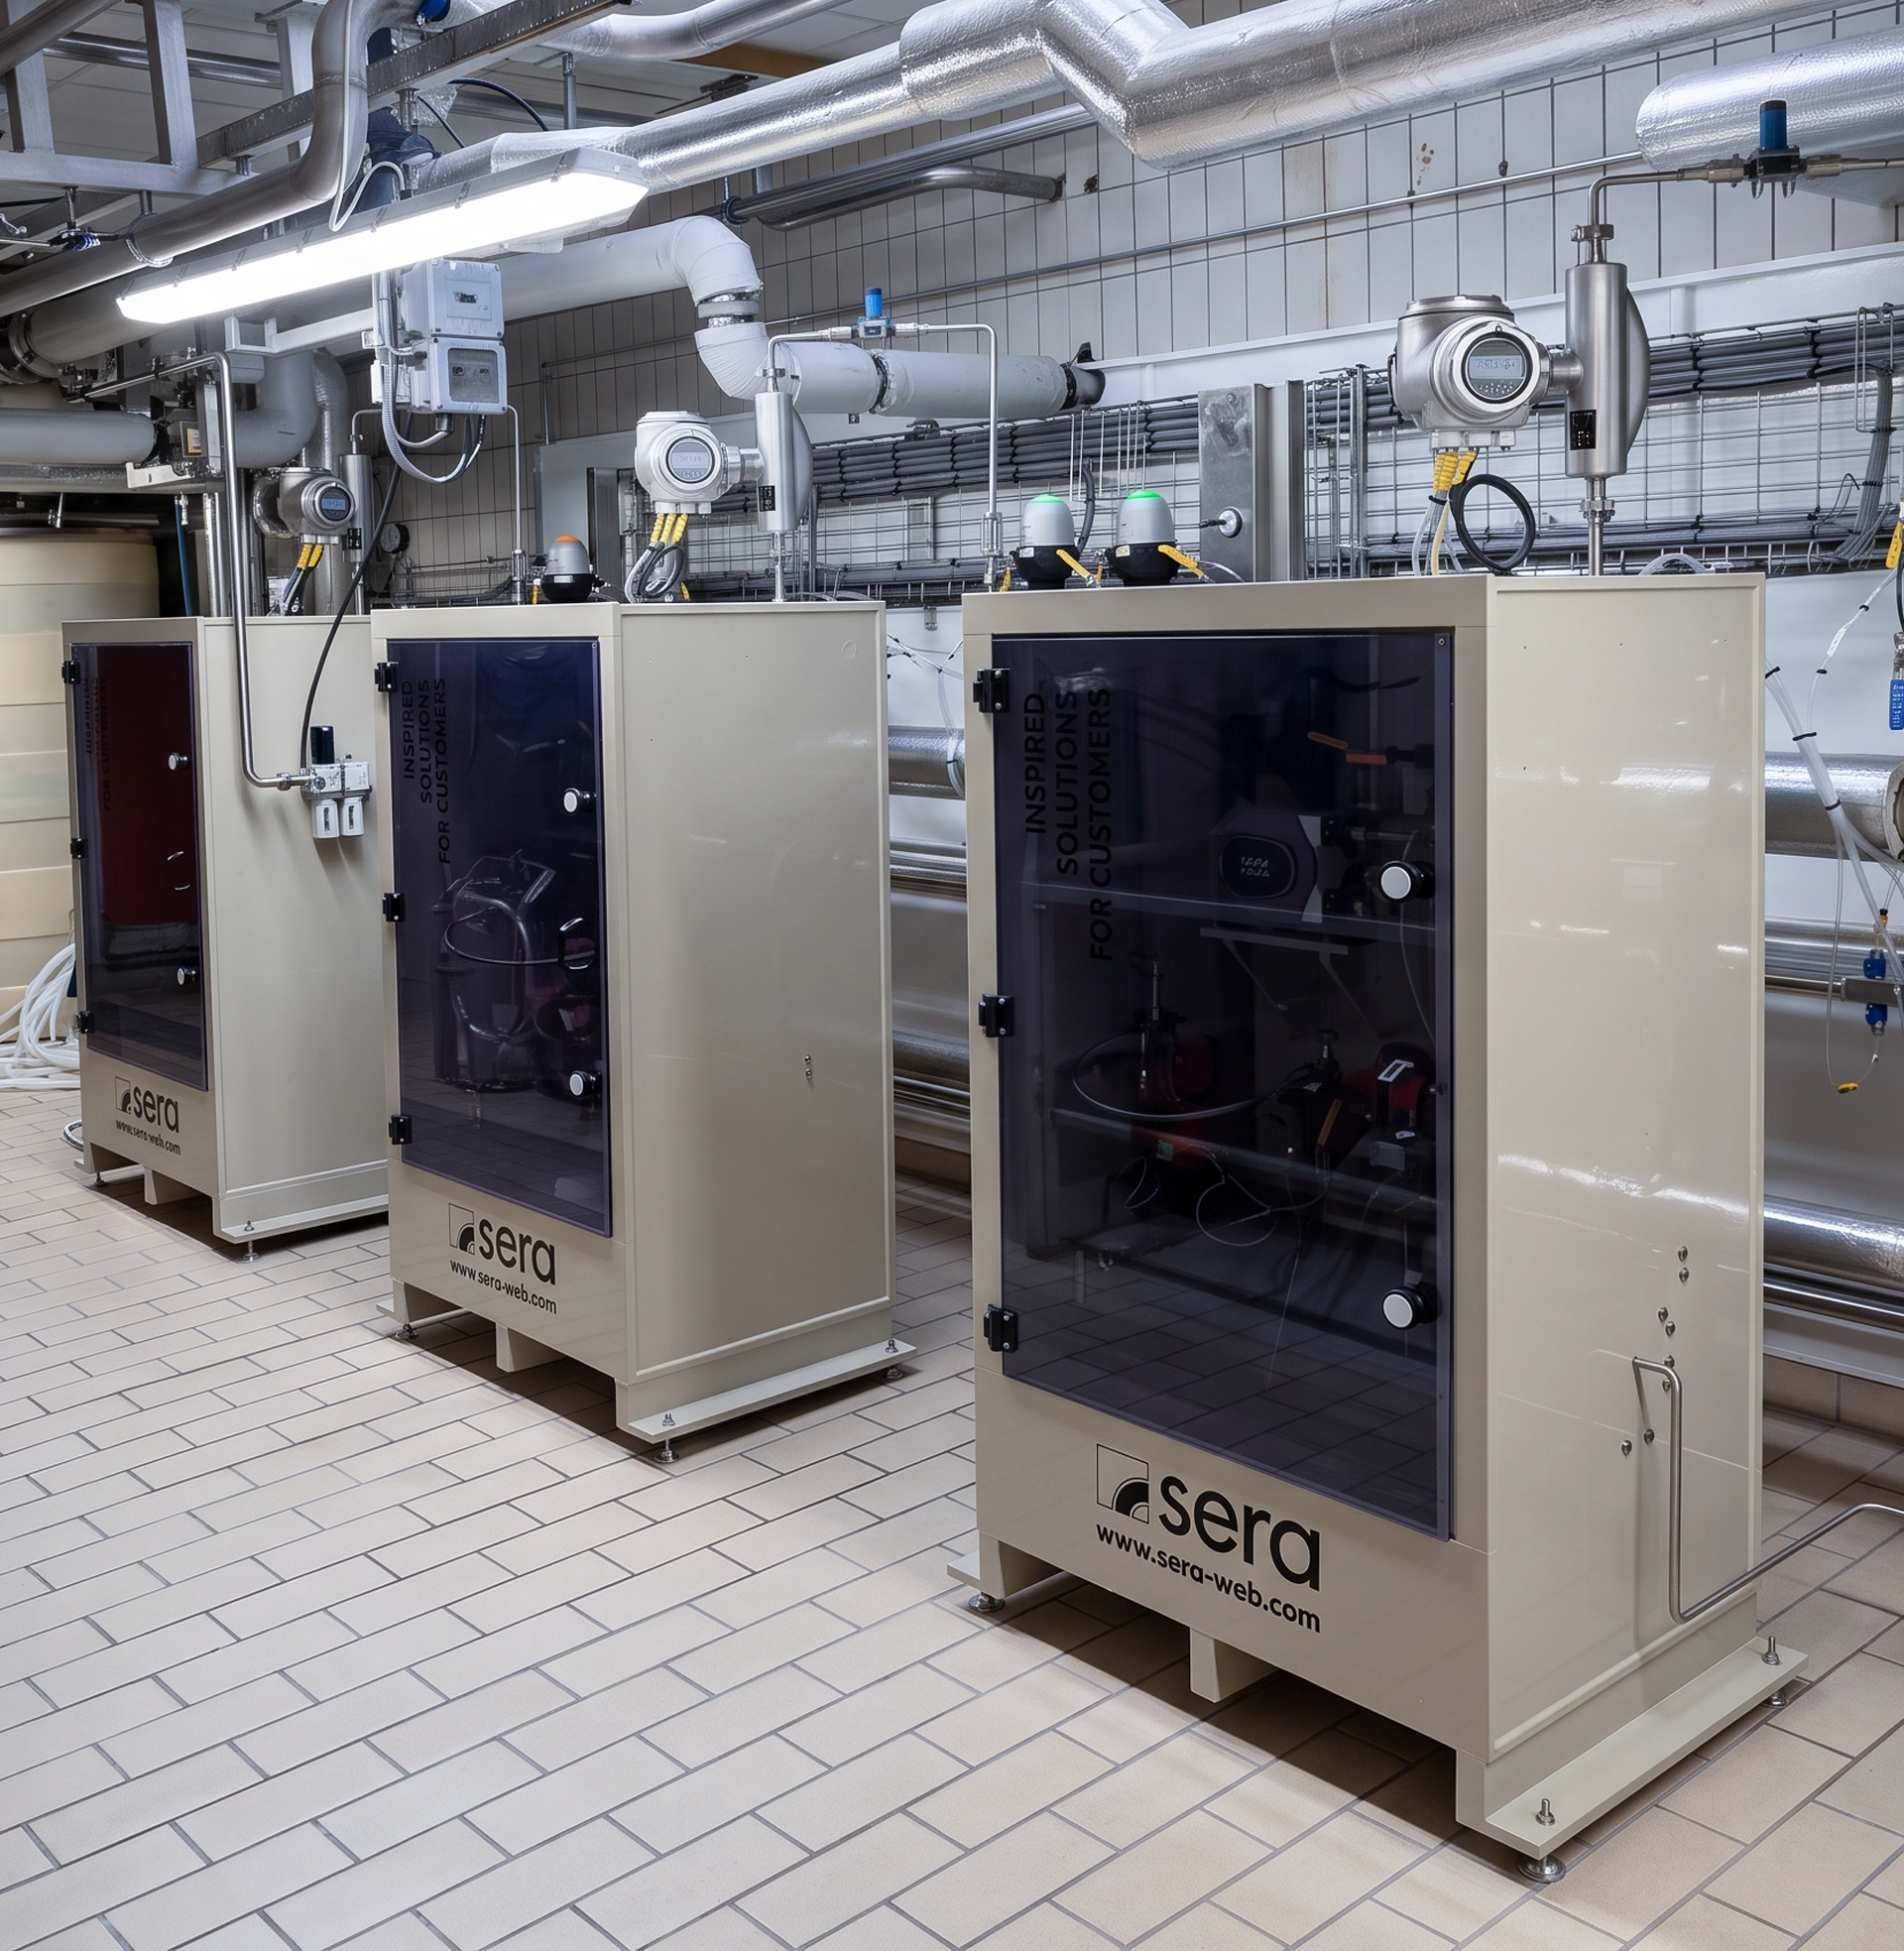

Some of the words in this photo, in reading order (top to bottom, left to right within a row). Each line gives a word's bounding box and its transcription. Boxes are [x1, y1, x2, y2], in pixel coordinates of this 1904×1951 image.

[401, 680, 416, 780] INSPIRED
[417, 678, 432, 804] SOLUTIONS
[433, 677, 449, 813] CUSTOMERS
[1023, 693, 1046, 834] INSPIRED
[1054, 689, 1079, 876] SOLUTIONS
[437, 820, 450, 864] FOR
[1087, 687, 1113, 888] CUSTOMERS
[1089, 899, 1113, 962] FOR
[133, 1086, 179, 1134] sera
[449, 1259, 557, 1314] wwwsera-web.com
[478, 1218, 556, 1285] sera
[1096, 1523, 1321, 1634] www.sera-web.com
[1157, 1475, 1321, 1592] sera
